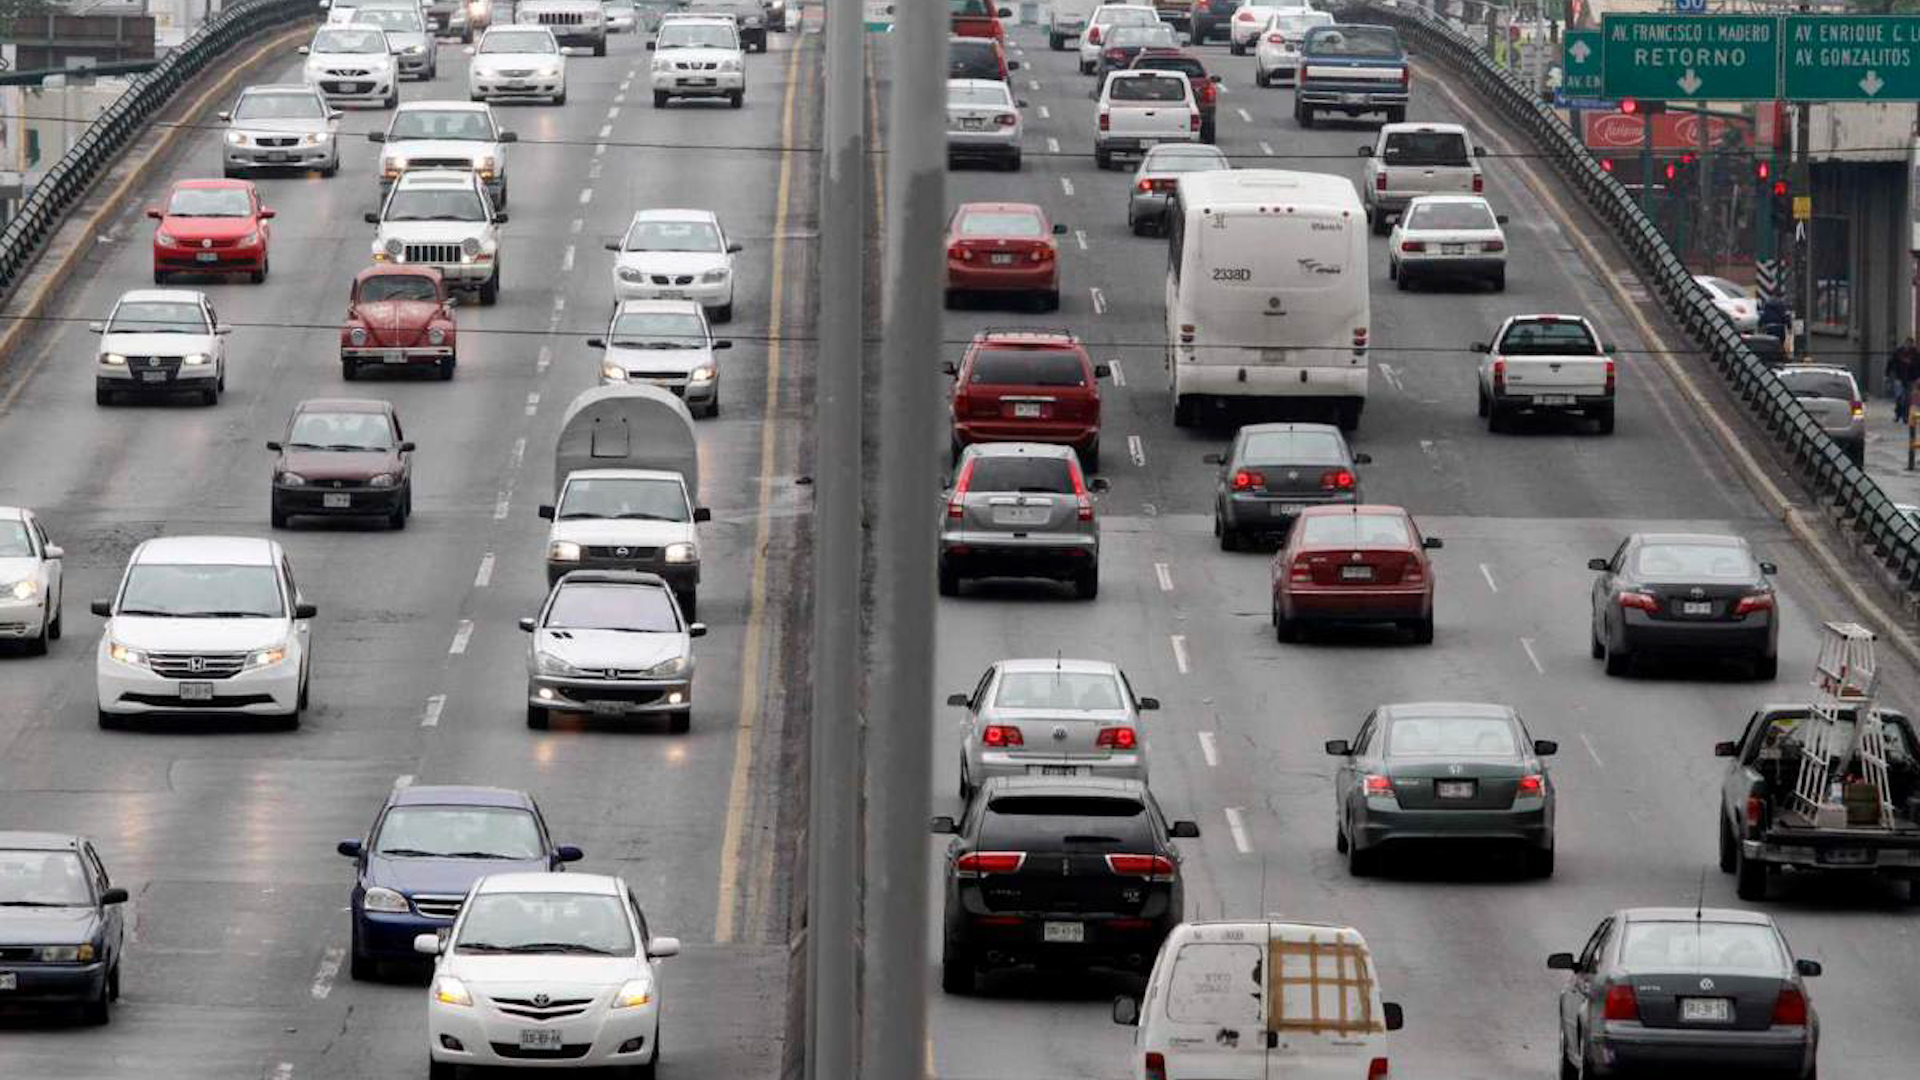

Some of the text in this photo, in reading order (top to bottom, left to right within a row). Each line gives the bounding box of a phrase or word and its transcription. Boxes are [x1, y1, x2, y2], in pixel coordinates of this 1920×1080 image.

[1612, 24, 1629, 42] AV.
[1632, 24, 1701, 42] FRANCISCO
[1718, 24, 1770, 42] MADERO
[1820, 24, 1883, 42] ENRIQUE
[1635, 48, 1746, 66] RETORNO
[1795, 48, 1910, 67] AV. GONZALITOS
[1212, 267, 1252, 281] 2338D
